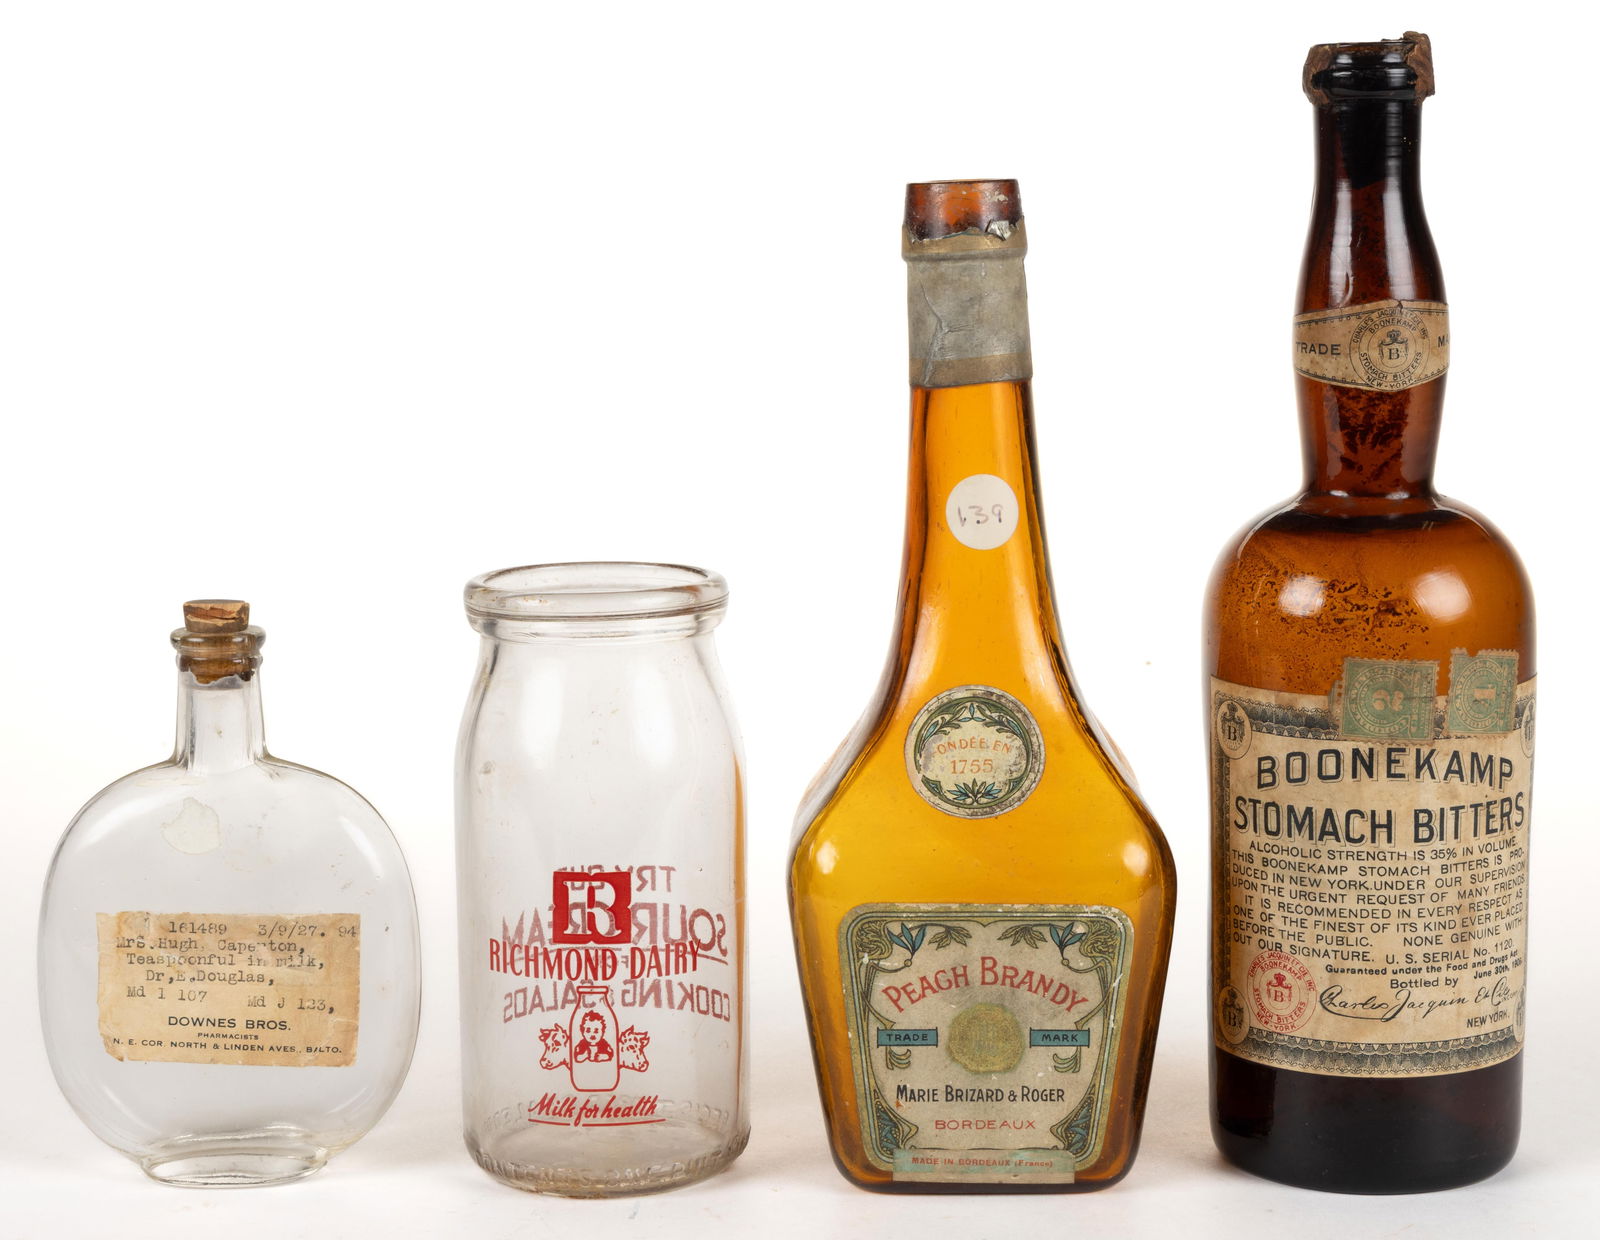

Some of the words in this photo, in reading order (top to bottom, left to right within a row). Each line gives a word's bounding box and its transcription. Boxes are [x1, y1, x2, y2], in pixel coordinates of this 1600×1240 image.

[1369, 318, 1416, 334] BOONEKAMP
[1296, 342, 1341, 356] TRADE
[1388, 347, 1400, 360] B
[1360, 352, 1389, 380] STOMACH
[1392, 352, 1421, 381] BITTERS
[933, 736, 986, 755] ONDÉE
[992, 740, 1011, 753] EN
[951, 758, 993, 774] 1755
[1257, 747, 1513, 790] BOONEKAMP
[1233, 796, 1394, 845] STOMACH
[1414, 792, 1525, 845] BITTERS
[1249, 842, 1322, 860] ALCOHOLIC
[1327, 850, 1407, 861] STRENGTH
[1413, 850, 1425, 861] IS
[1430, 848, 1457, 860] 35%
[1462, 846, 1474, 857] IN
[1232, 849, 1254, 864] THIS
[1262, 857, 1348, 876] BOONEKAMP
[1358, 865, 1430, 877] STOMACH
[1441, 858, 1490, 874] BITTERS
[1494, 854, 1503, 865] IS
[1232, 863, 1268, 881] DUCED
[1272, 873, 1285, 883] IN
[1289, 876, 1322, 888] NEW
[1435, 876, 1462, 889] OUR
[1470, 861, 1525, 885] SUPERVISION
[1232, 877, 1258, 892] UPON
[1260, 884, 1285, 898] THE
[1290, 889, 1347, 904] URGENT
[1357, 893, 1426, 905] REQUEST
[1430, 891, 1449, 903] OF
[1457, 886, 1489, 900] MANY
[1494, 873, 1525, 894] FRIENDS
[1245, 894, 1254, 905] IT
[1261, 898, 1271, 910] IS
[1278, 901, 1392, 919] RECOMMENDED
[1397, 908, 1411, 919] IN
[1417, 904, 1462, 918] EVERY
[1468, 894, 1512, 912] RESPECT
[1515, 888, 1523, 900] AS
[1233, 904, 1254, 919] ONE
[1260, 911, 1276, 923] OF
[1281, 916, 1308, 929] THE
[1313, 920, 1365, 933] FINEST
[1370, 922, 1391, 933] OF
[1396, 922, 1418, 933] ITS
[1423, 919, 1457, 932] KIND
[1461, 913, 1492, 928] EVER
[1494, 902, 1524, 921] PLACED
[169, 921, 227, 935] 161489
[338, 926, 357, 938] 94
[1233, 919, 1275, 938] BEFORE
[1278, 929, 1306, 942] THE
[1316, 934, 1373, 947] PUBLIC.
[1403, 935, 1443, 947] NONE
[1450, 925, 1500, 944] GENUINE
[1233, 932, 1252, 945] OUT
[1258, 938, 1283, 952] OUR
[1289, 944, 1375, 963] SIGNATURE.
[1385, 954, 1399, 964] U.
[1405, 953, 1417, 964] S.
[1422, 950, 1469, 963] SERIAL
[1473, 947, 1490, 958] No.
[126, 953, 236, 967] Teaspoonful
[247, 955, 267, 967] in
[276, 955, 324, 970] milk,
[489, 938, 617, 981] RICHMOND
[630, 939, 701, 978] DAIRY
[1325, 964, 1387, 975] Guaranteed
[1392, 965, 1422, 975] under
[1425, 965, 1442, 973] the
[1446, 963, 1468, 972] Food
[1471, 960, 1487, 969] and
[1489, 954, 1508, 965] Drugs
[1259, 961, 1303, 981] BOONEKAMP
[1473, 970, 1492, 980] June
[980, 956, 1089, 1013] BRANDY
[1390, 978, 1439, 989] Bottled
[1445, 976, 1459, 988] by
[127, 986, 146, 997] Md
[178, 989, 207, 1003] 107
[247, 995, 266, 1008] Md
[297, 998, 334, 1014] 123,
[1319, 985, 1389, 1019] Charles
[168, 1016, 236, 1029] DOWNES
[246, 1019, 291, 1031] BROS.
[1466, 1015, 1487, 1028] NEW
[198, 1032, 259, 1040] PHARMACISTS
[886, 1033, 929, 1042] TRADE
[1041, 1034, 1079, 1042] MARK
[170, 1041, 207, 1050] NORTH
[224, 1042, 264, 1052] LINDEN
[1008, 1091, 1017, 1102] &
[528, 1093, 575, 1118] Milk
[574, 1102, 600, 1126] for
[599, 1095, 658, 1118] health
[935, 1120, 1036, 1130] BORDEAUX
[912, 1157, 939, 1165] MADE
[958, 1158, 1010, 1167] BORDEAUX
[1014, 1159, 1053, 1168] (France)
